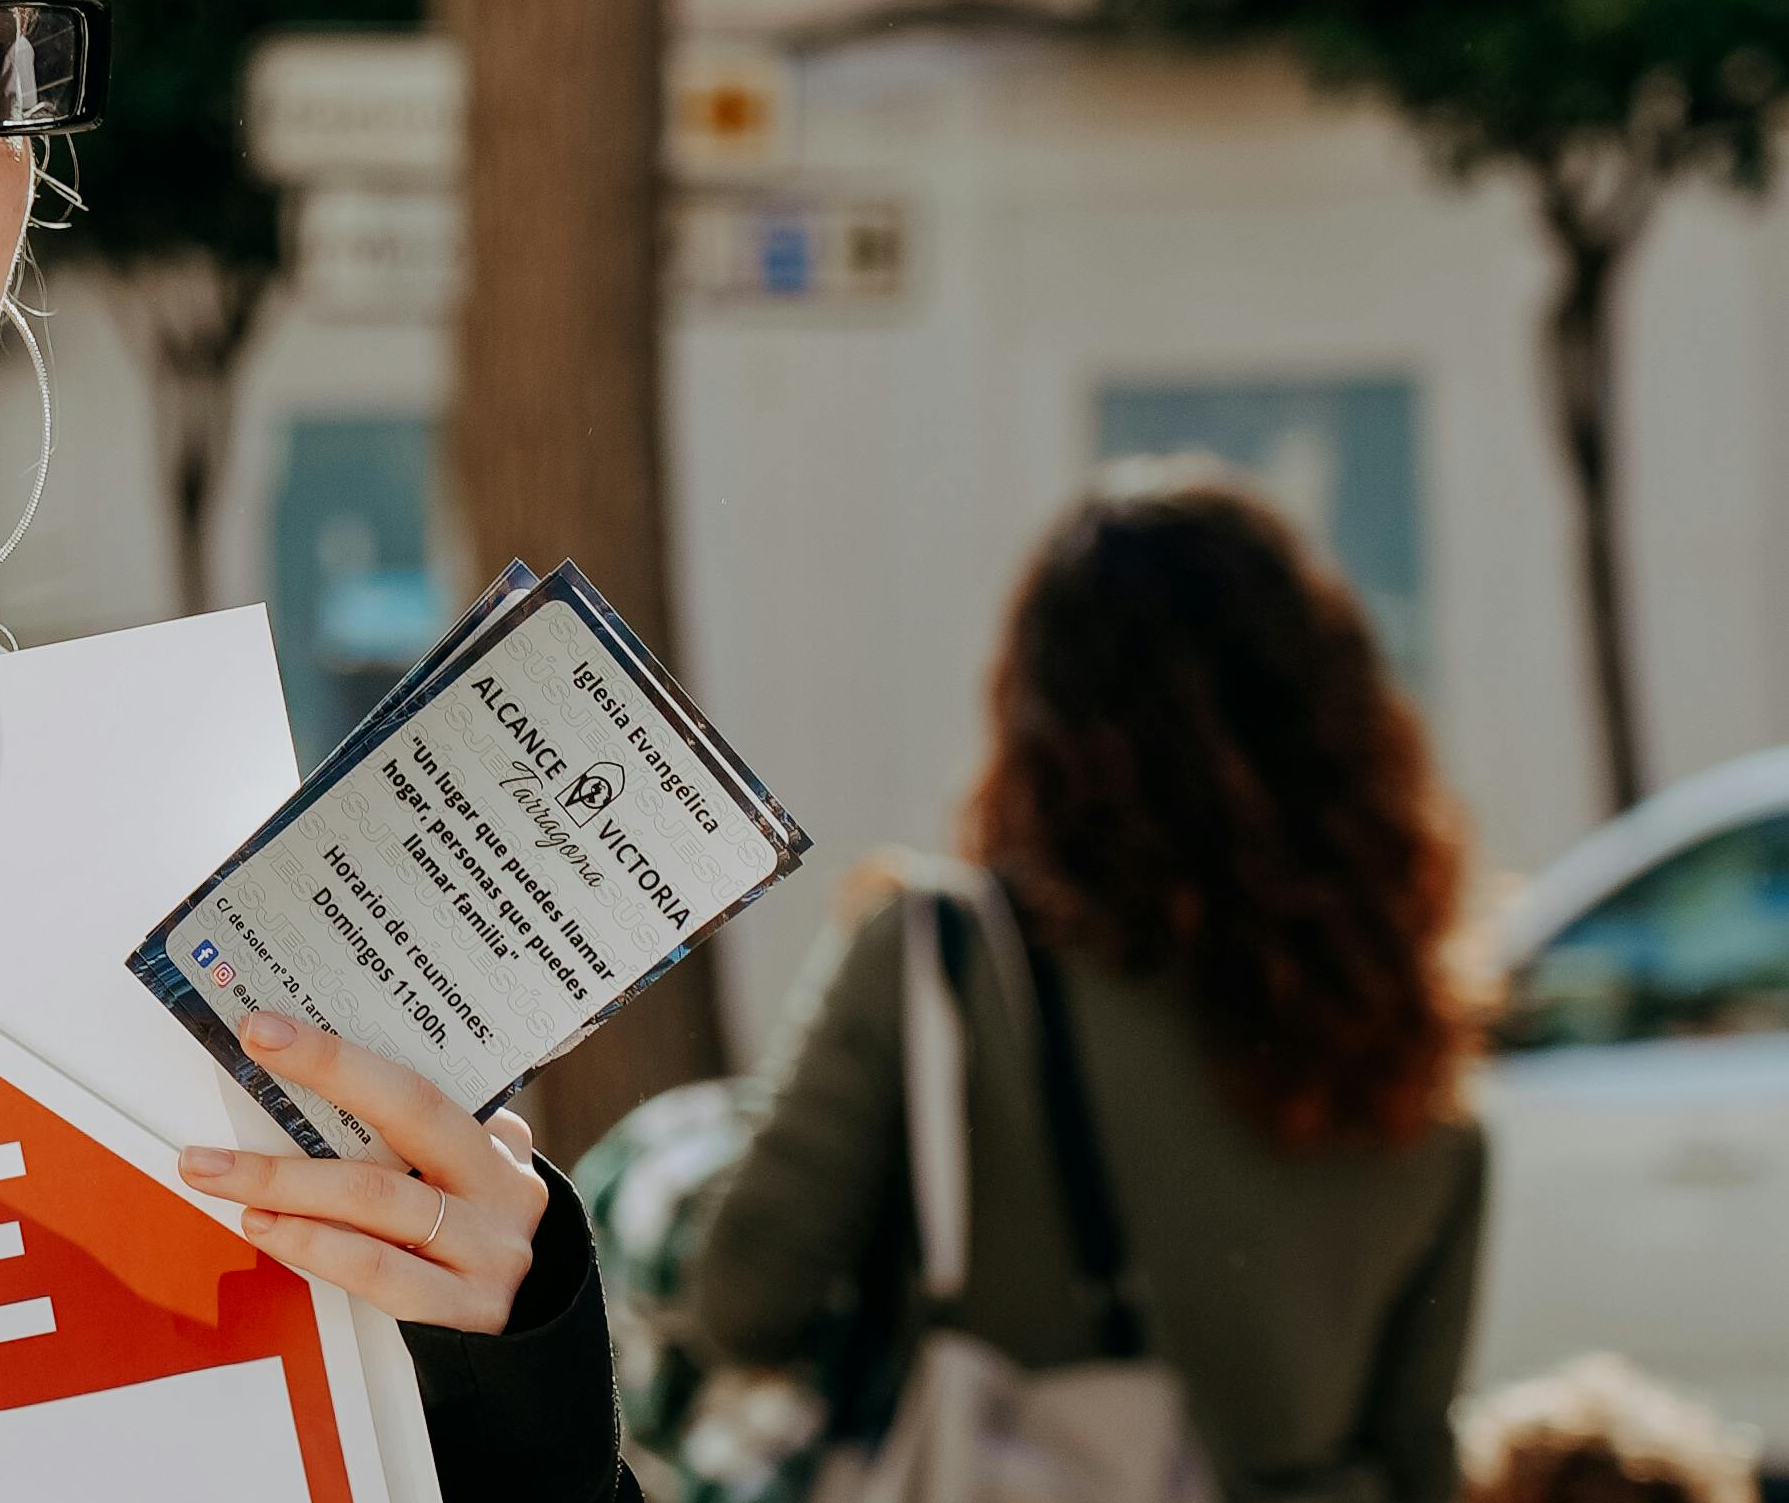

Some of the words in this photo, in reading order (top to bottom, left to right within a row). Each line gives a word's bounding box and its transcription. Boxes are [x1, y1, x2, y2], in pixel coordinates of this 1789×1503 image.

[469, 675, 568, 781] ALCANCE
[597, 817, 690, 931] VICTORIA
[497, 759, 605, 888] Tarragona
[571, 659, 630, 730] Iglesia
[626, 725, 718, 834] Evangélica
[321, 843, 387, 919] Horario
[383, 918, 409, 946] de
[405, 944, 494, 1045] reuniones:
[380, 757, 432, 822] hogar,
[425, 817, 502, 900] personas
[498, 899, 532, 936] que
[523, 933, 588, 1000] puedes
[401, 832, 457, 894] llamar
[451, 891, 519, 960] familia"
[411, 735, 438, 777] "Un
[433, 769, 480, 821] lugar
[474, 821, 508, 858] que
[499, 856, 564, 923] puedes
[559, 918, 615, 980] llamar
[215, 896, 233, 913] C/
[227, 912, 245, 932] de
[241, 927, 273, 962] Soler
[281, 974, 300, 999] 20,
[311, 886, 395, 982] Domingos
[392, 979, 446, 1050] 11:00h.
